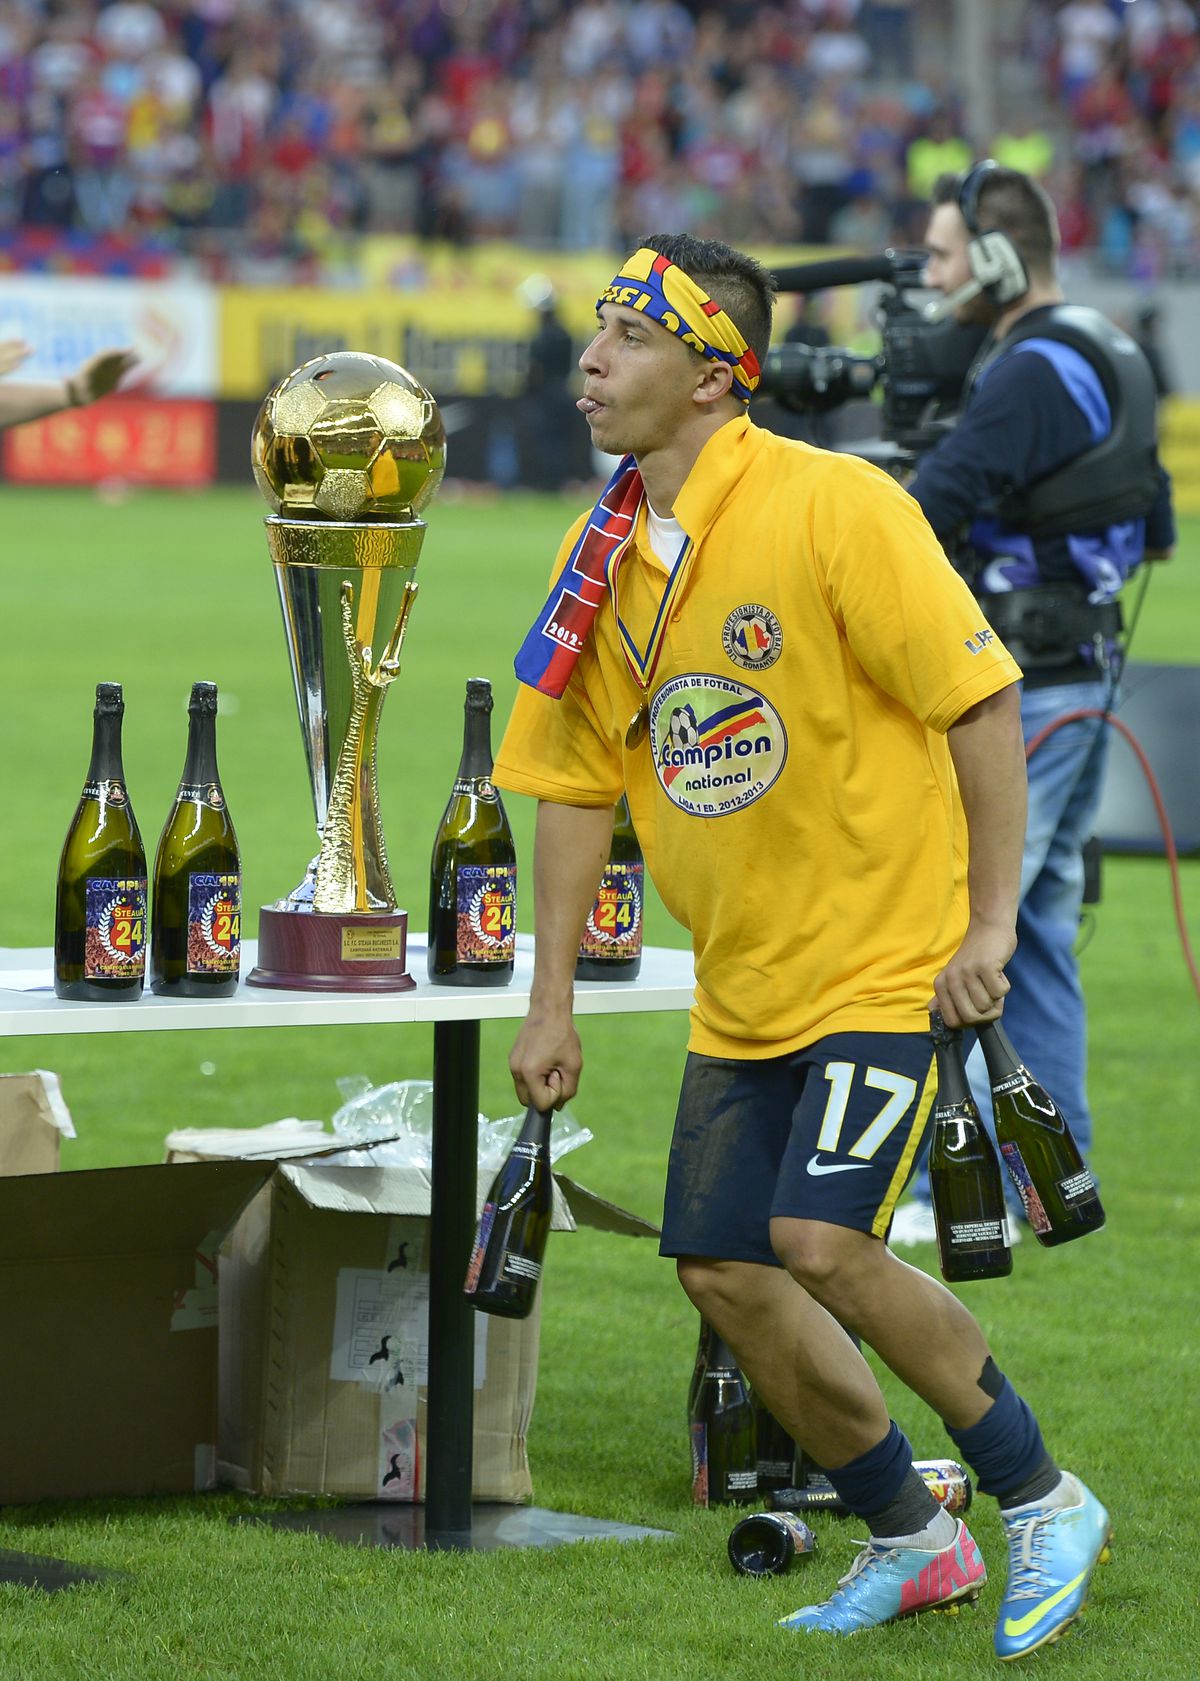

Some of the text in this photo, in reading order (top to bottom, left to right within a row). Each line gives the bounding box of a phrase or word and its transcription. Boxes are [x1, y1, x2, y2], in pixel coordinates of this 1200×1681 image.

[723, 605, 782, 662] LIGA PROFESIONISTA DE FOTBAL
[742, 655, 775, 670] ROMANIA
[651, 679, 689, 727] PROFESIONISTA
[691, 678, 702, 687] DE
[704, 678, 743, 696] FOTBAL
[662, 735, 771, 769] Campion
[685, 768, 752, 791] national
[678, 781, 764, 813] LIGA 1 ED. 2012-2013
[216, 900, 240, 912] STEAUA
[484, 893, 513, 903] STEAUA
[599, 890, 633, 901] STEAUA
[114, 907, 143, 917] STEAUA
[486, 905, 512, 931] 24
[599, 903, 630, 928] 24
[116, 920, 142, 946] 24
[217, 915, 240, 941] 24
[817, 1061, 918, 1160] 17
[899, 1521, 985, 1616] NIKE
